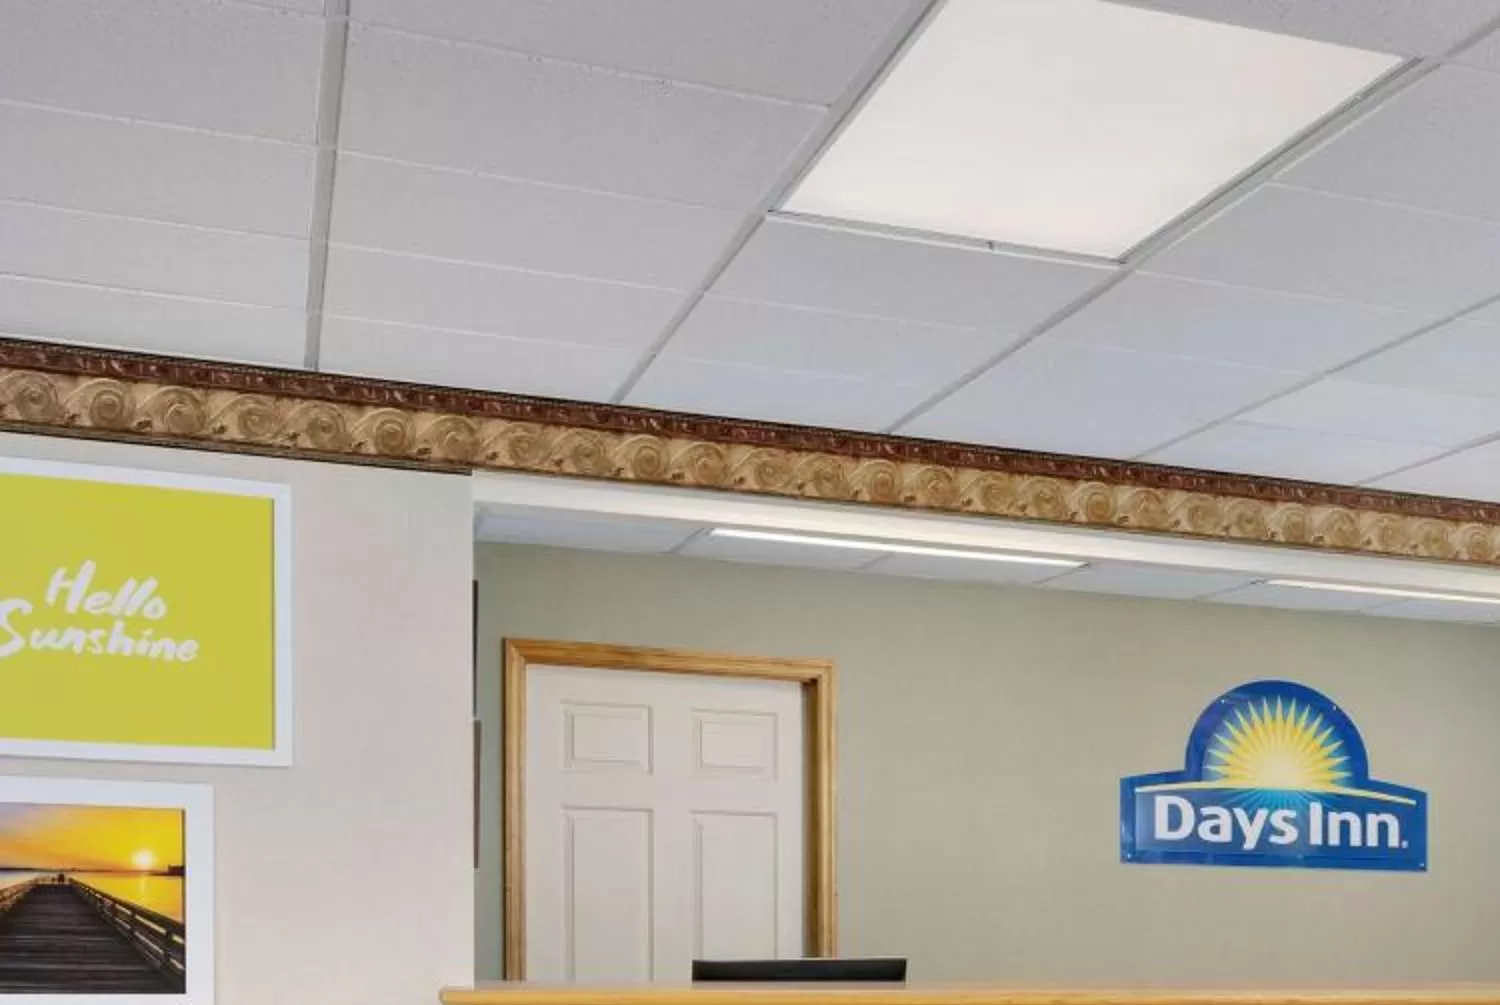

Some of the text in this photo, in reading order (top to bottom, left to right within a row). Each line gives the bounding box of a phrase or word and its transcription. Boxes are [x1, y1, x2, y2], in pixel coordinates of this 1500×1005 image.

[45, 559, 167, 620] Hello
[0, 598, 199, 662] Sunshine
[1153, 795, 1299, 850] Days
